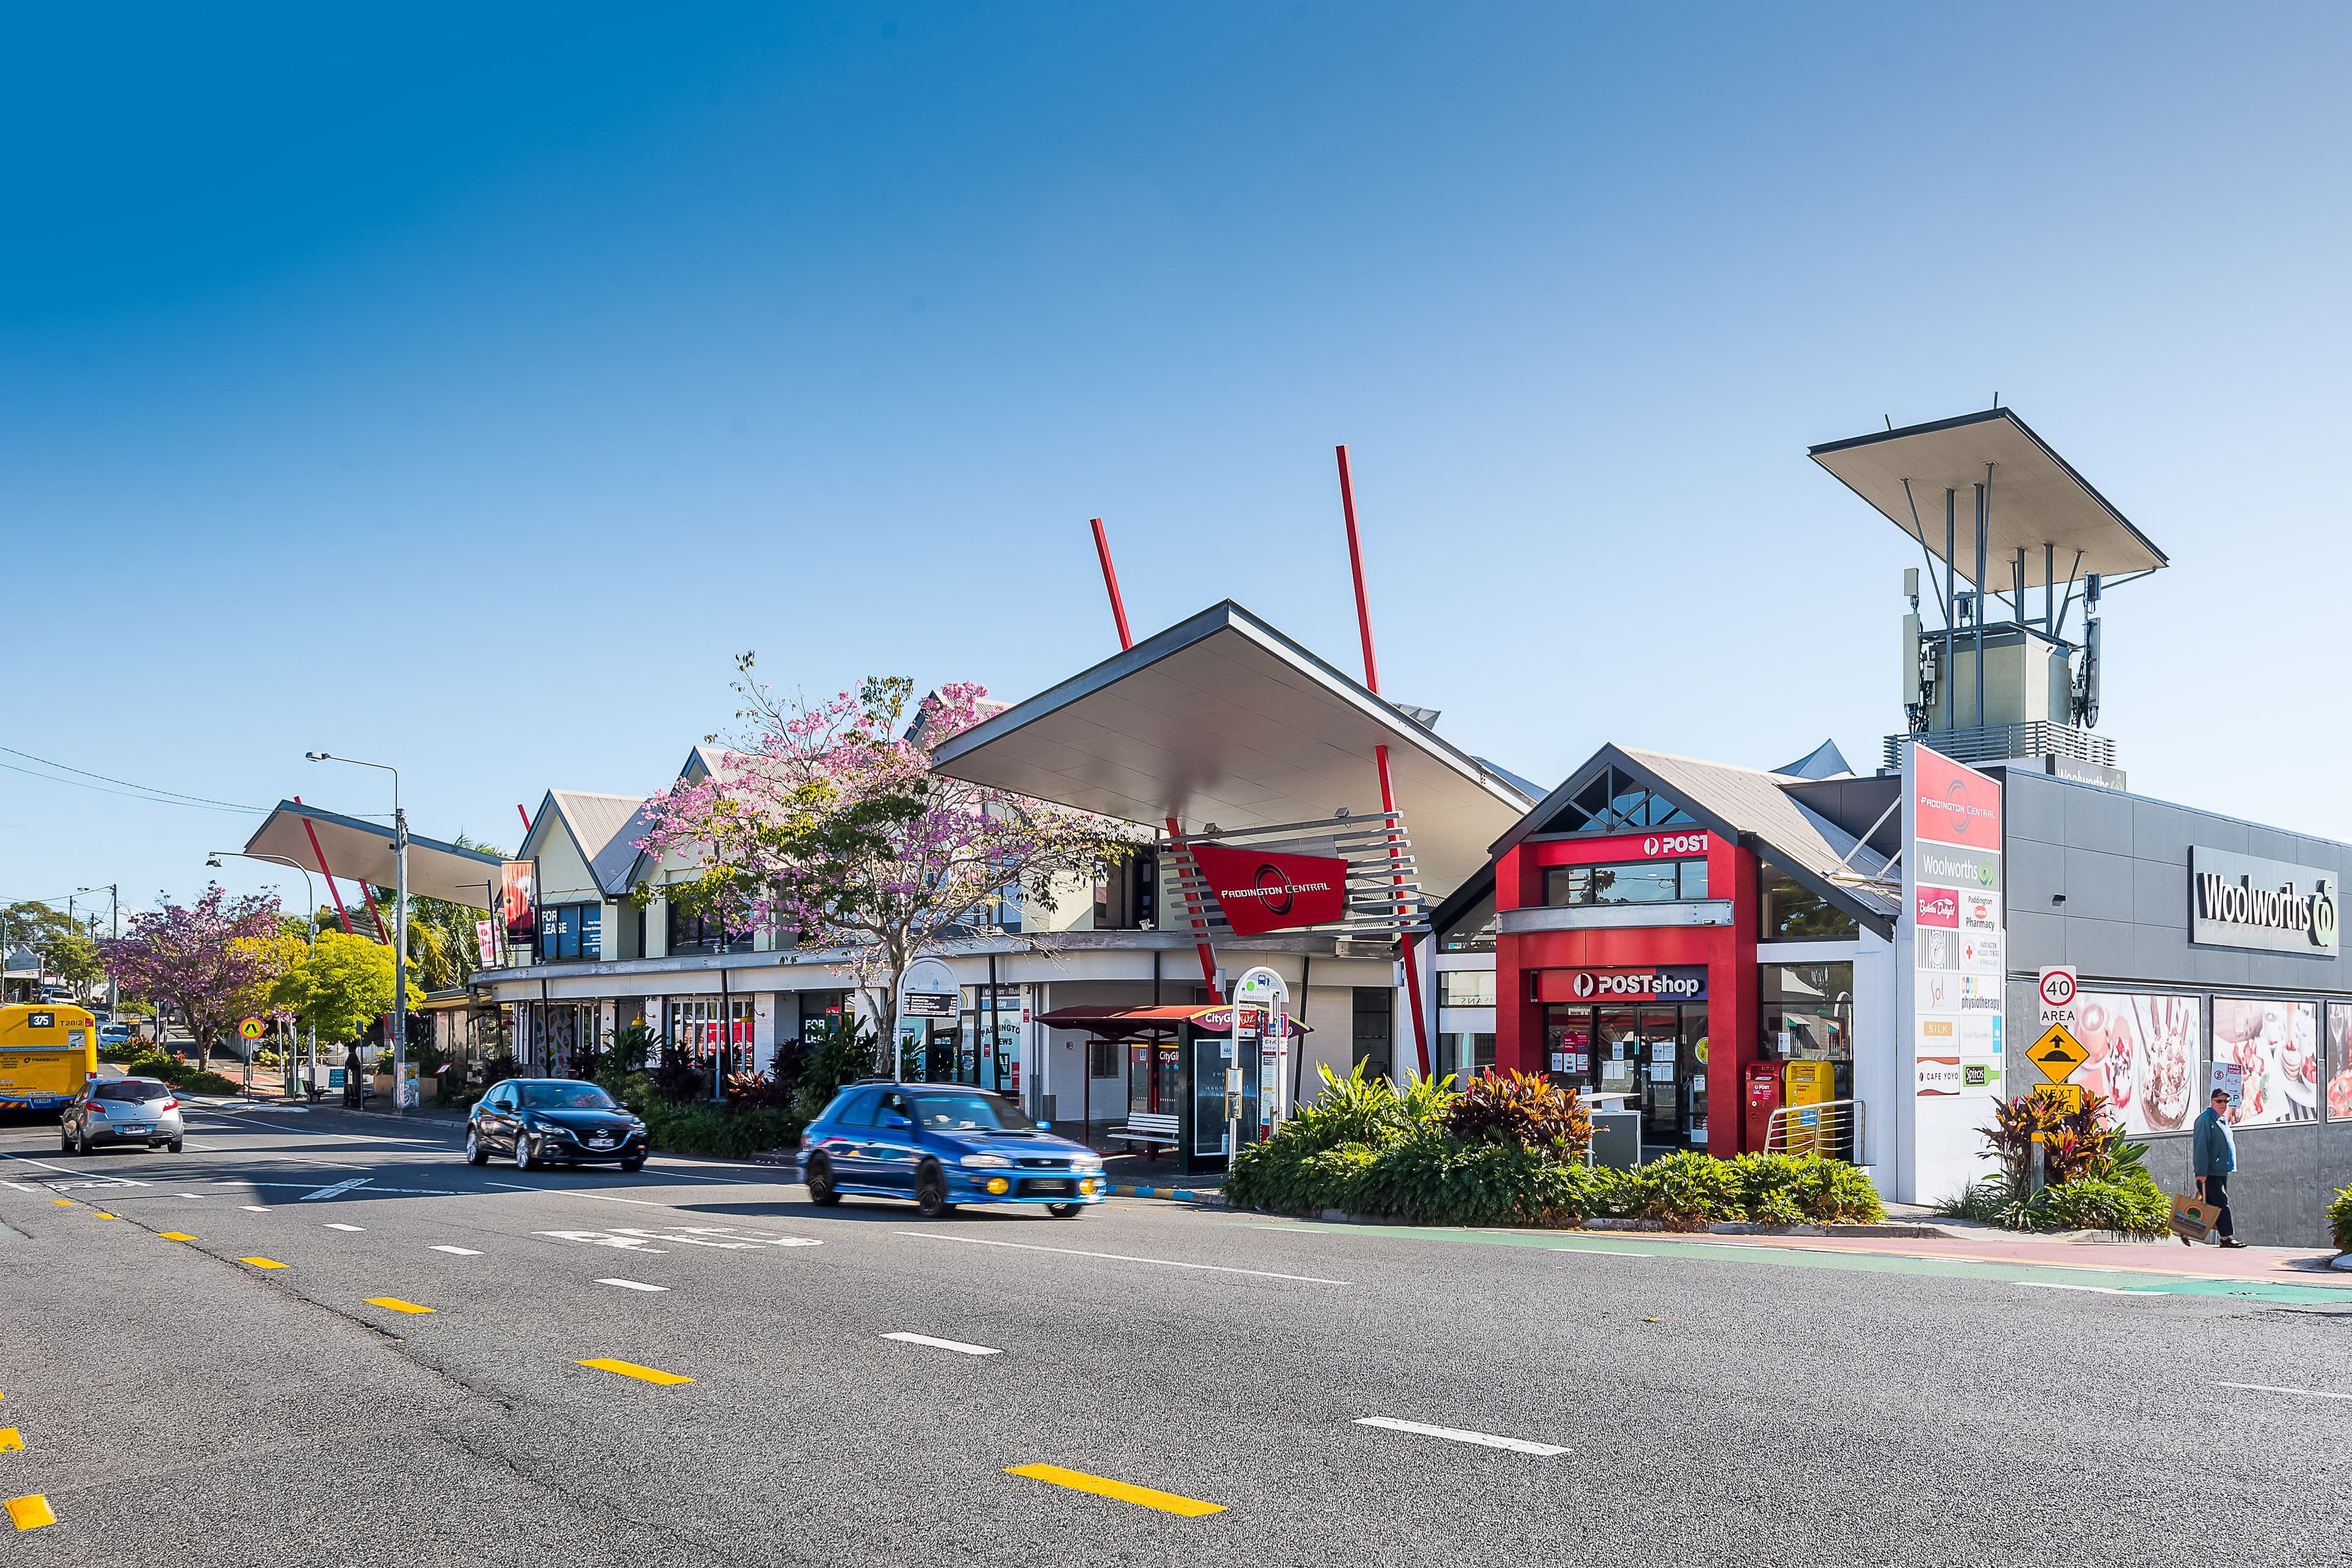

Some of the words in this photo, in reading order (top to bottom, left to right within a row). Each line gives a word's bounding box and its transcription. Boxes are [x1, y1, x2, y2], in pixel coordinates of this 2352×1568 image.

[1663, 835, 1708, 853] POST
[1923, 854, 1978, 880] Woolworths
[1968, 895, 1992, 906] Paddington
[2200, 872, 2312, 932] Woolworths
[542, 910, 557, 922] FOR
[1966, 917, 1994, 931] Pharmacy
[1599, 974, 1699, 997] POSTshop
[2046, 981, 2070, 995] 40
[1961, 995, 2000, 1010] physiotherapy
[33, 1016, 49, 1026] 375
[2041, 1011, 2075, 1021] AREA
[1928, 1023, 1948, 1034] SILK
[1966, 1068, 1984, 1080] Spiros
[2041, 1089, 2073, 1098] NEXT
